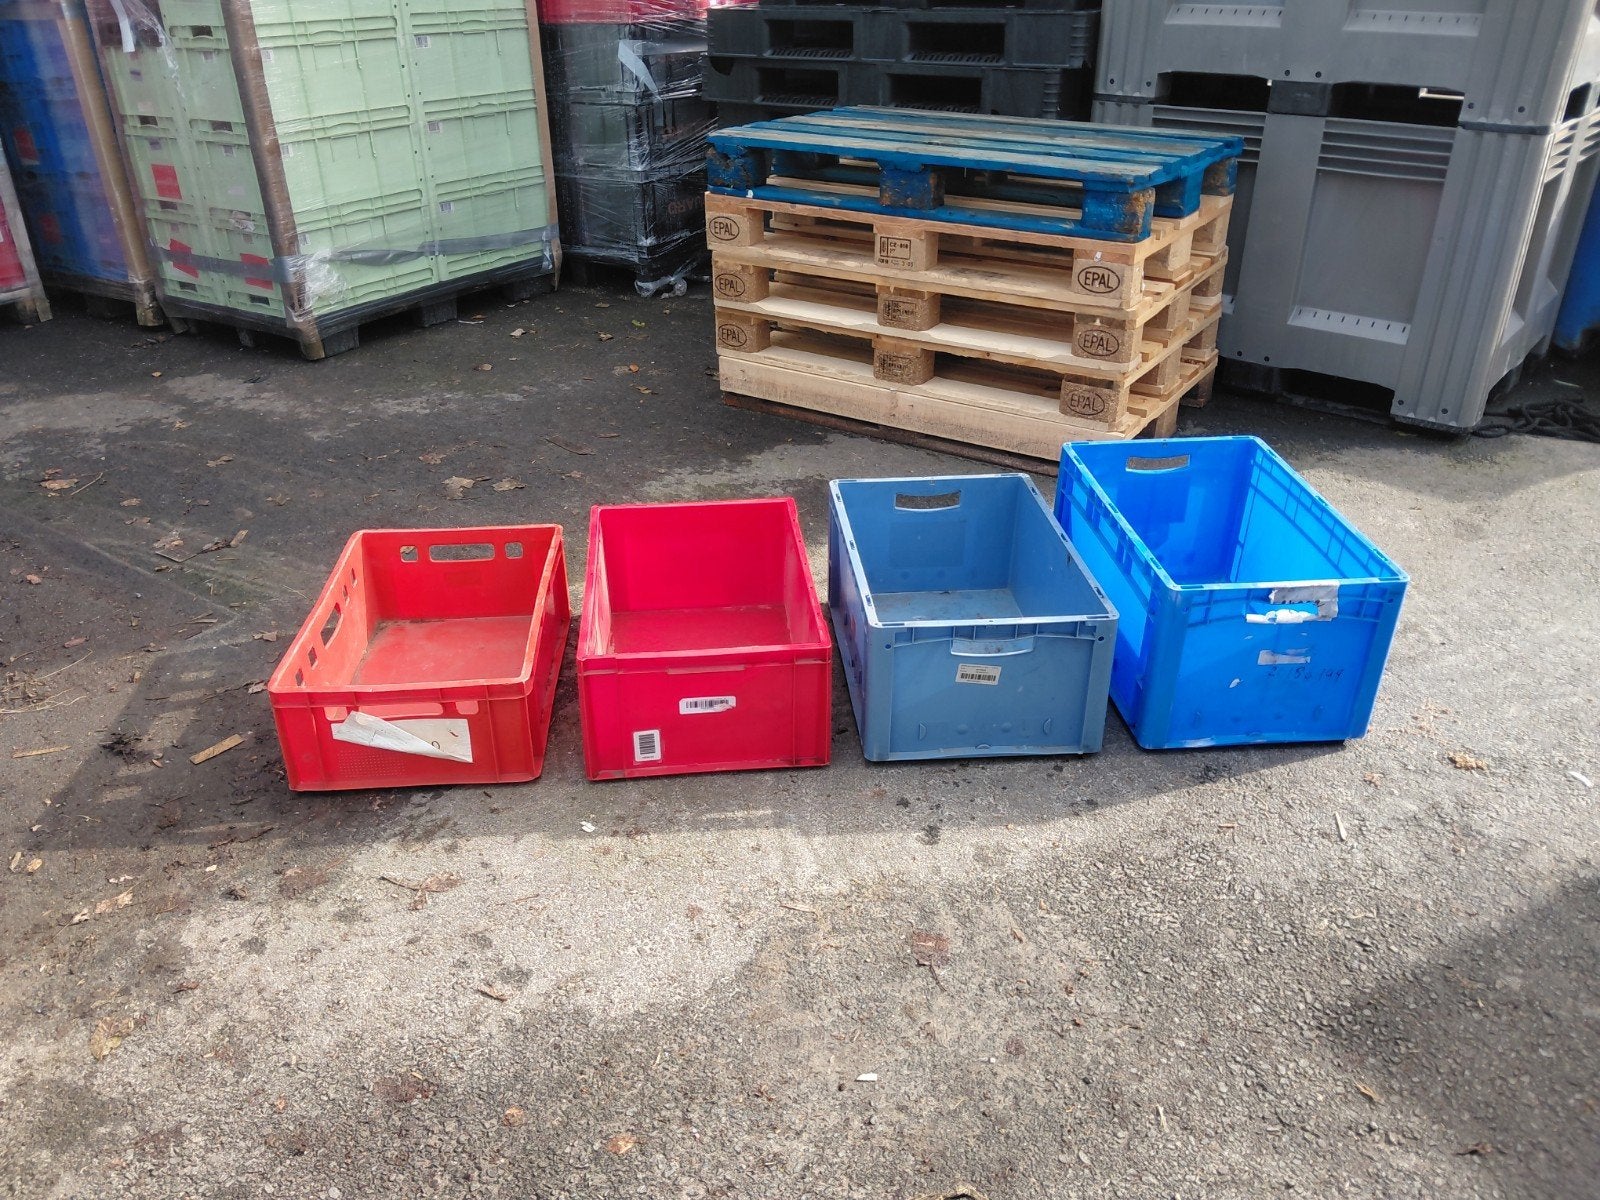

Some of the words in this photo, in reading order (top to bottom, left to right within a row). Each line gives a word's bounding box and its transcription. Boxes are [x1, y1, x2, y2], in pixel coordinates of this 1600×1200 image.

[713, 221, 735, 236] EPAL
[719, 279, 741, 293] EPAL
[1084, 271, 1114, 289] EPAL
[721, 329, 743, 343] EPAL
[1083, 334, 1113, 352] EPAL
[1070, 395, 1099, 412] EPAL
